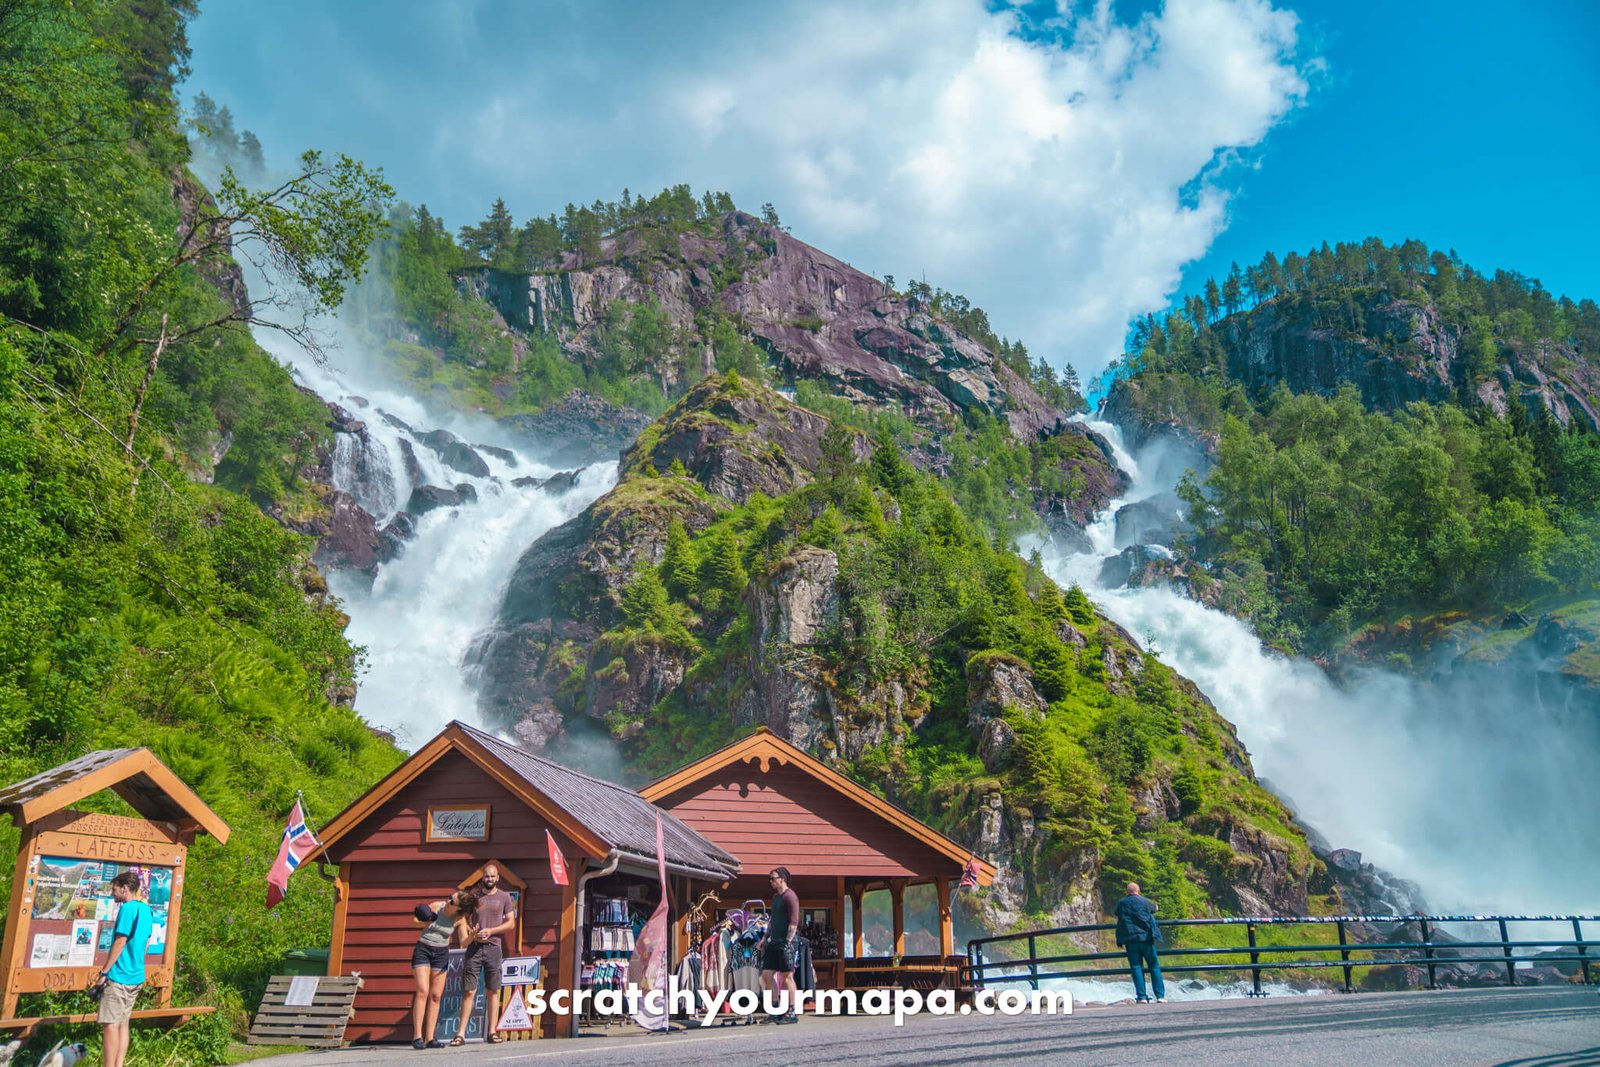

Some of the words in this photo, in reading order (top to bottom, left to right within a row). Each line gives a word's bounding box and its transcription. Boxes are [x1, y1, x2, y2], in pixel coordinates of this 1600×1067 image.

[75, 837, 156, 860] LÅTEFOSS
[43, 971, 75, 988] ODDA
[441, 1015, 484, 1036] TOST
